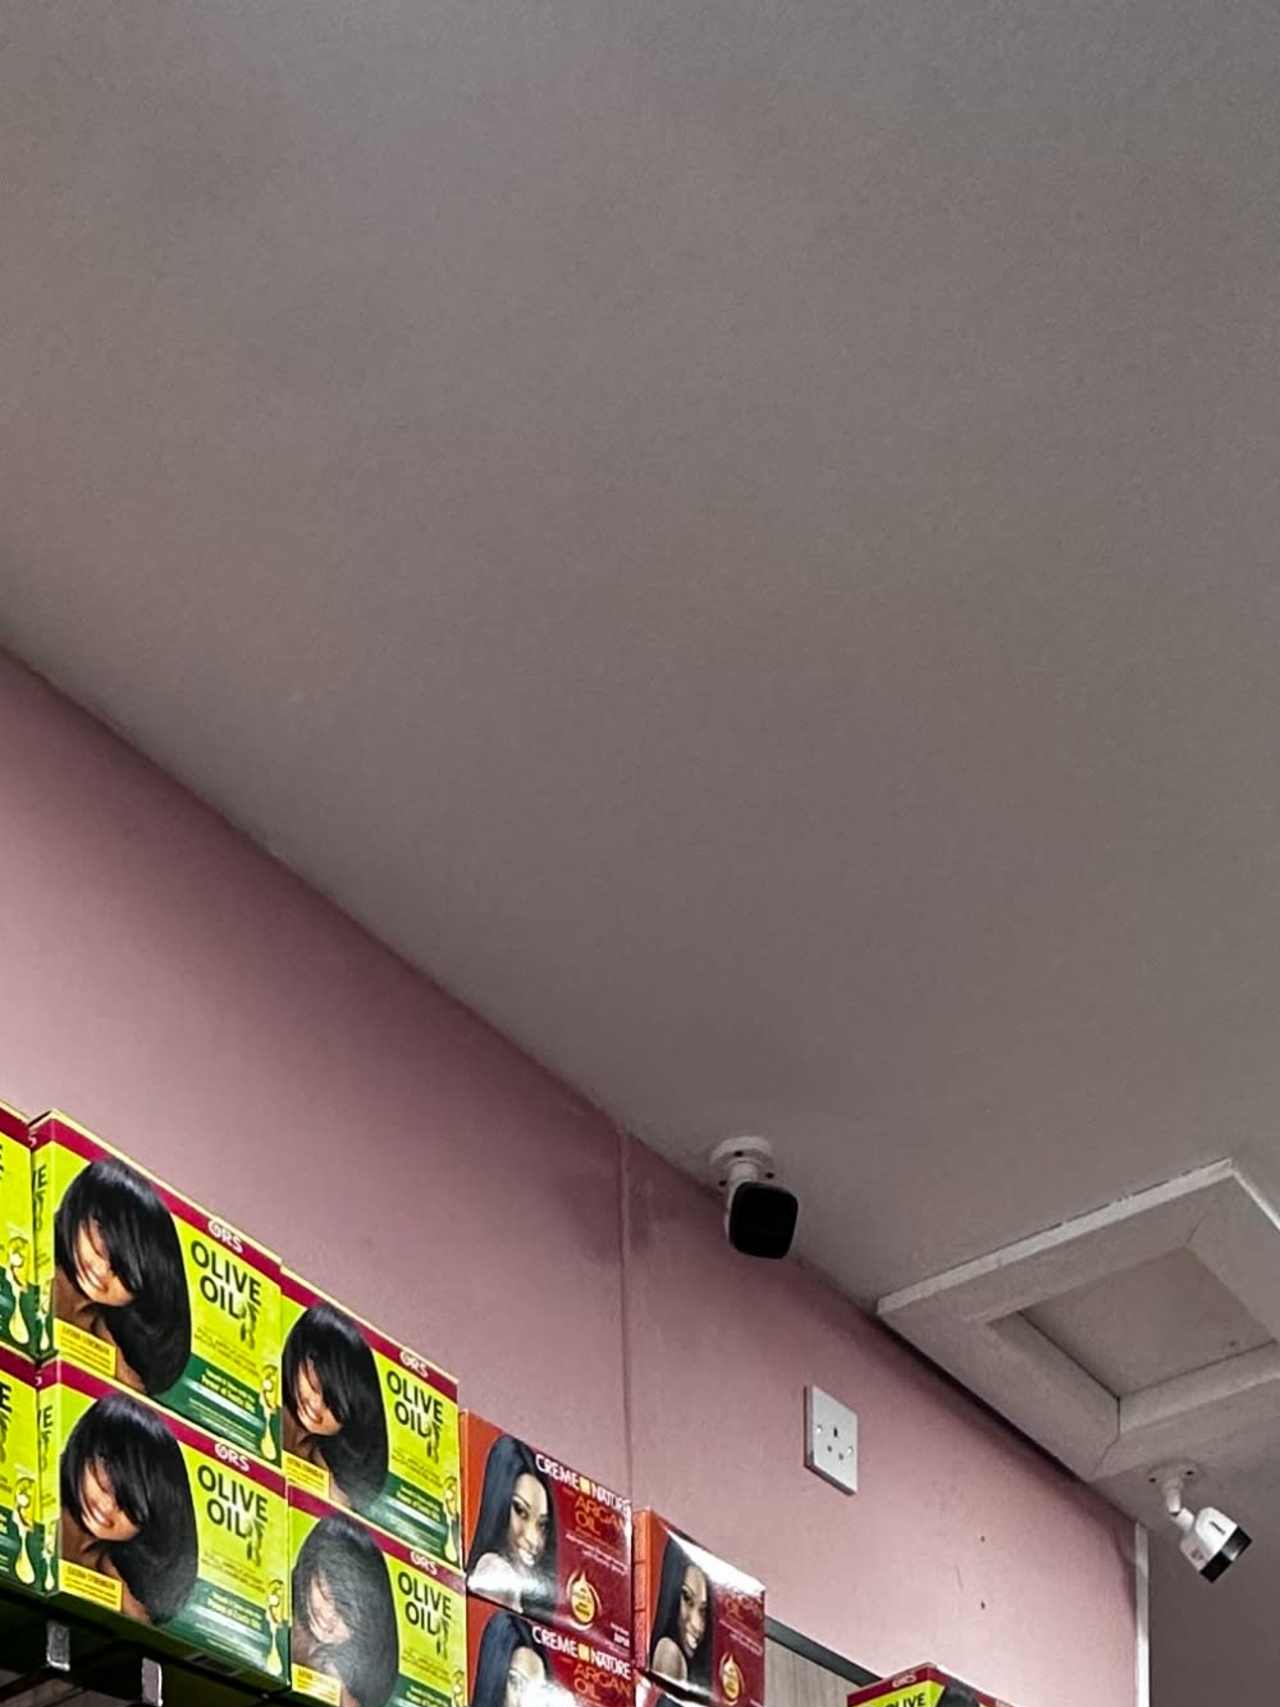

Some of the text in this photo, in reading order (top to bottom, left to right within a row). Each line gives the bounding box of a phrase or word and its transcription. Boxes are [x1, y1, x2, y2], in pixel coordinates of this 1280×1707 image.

[191, 1240, 262, 1307] OLIVE
[200, 1275, 240, 1321] OIL
[386, 1370, 443, 1425] OLIVE
[394, 1401, 432, 1438] OIL
[535, 1453, 580, 1488] CREME
[197, 1463, 268, 1524] OLIVE
[206, 1497, 248, 1538] OIL
[397, 1571, 452, 1619] OLIVE
[404, 1601, 440, 1636] OIL
[532, 1625, 579, 1658] CREME
